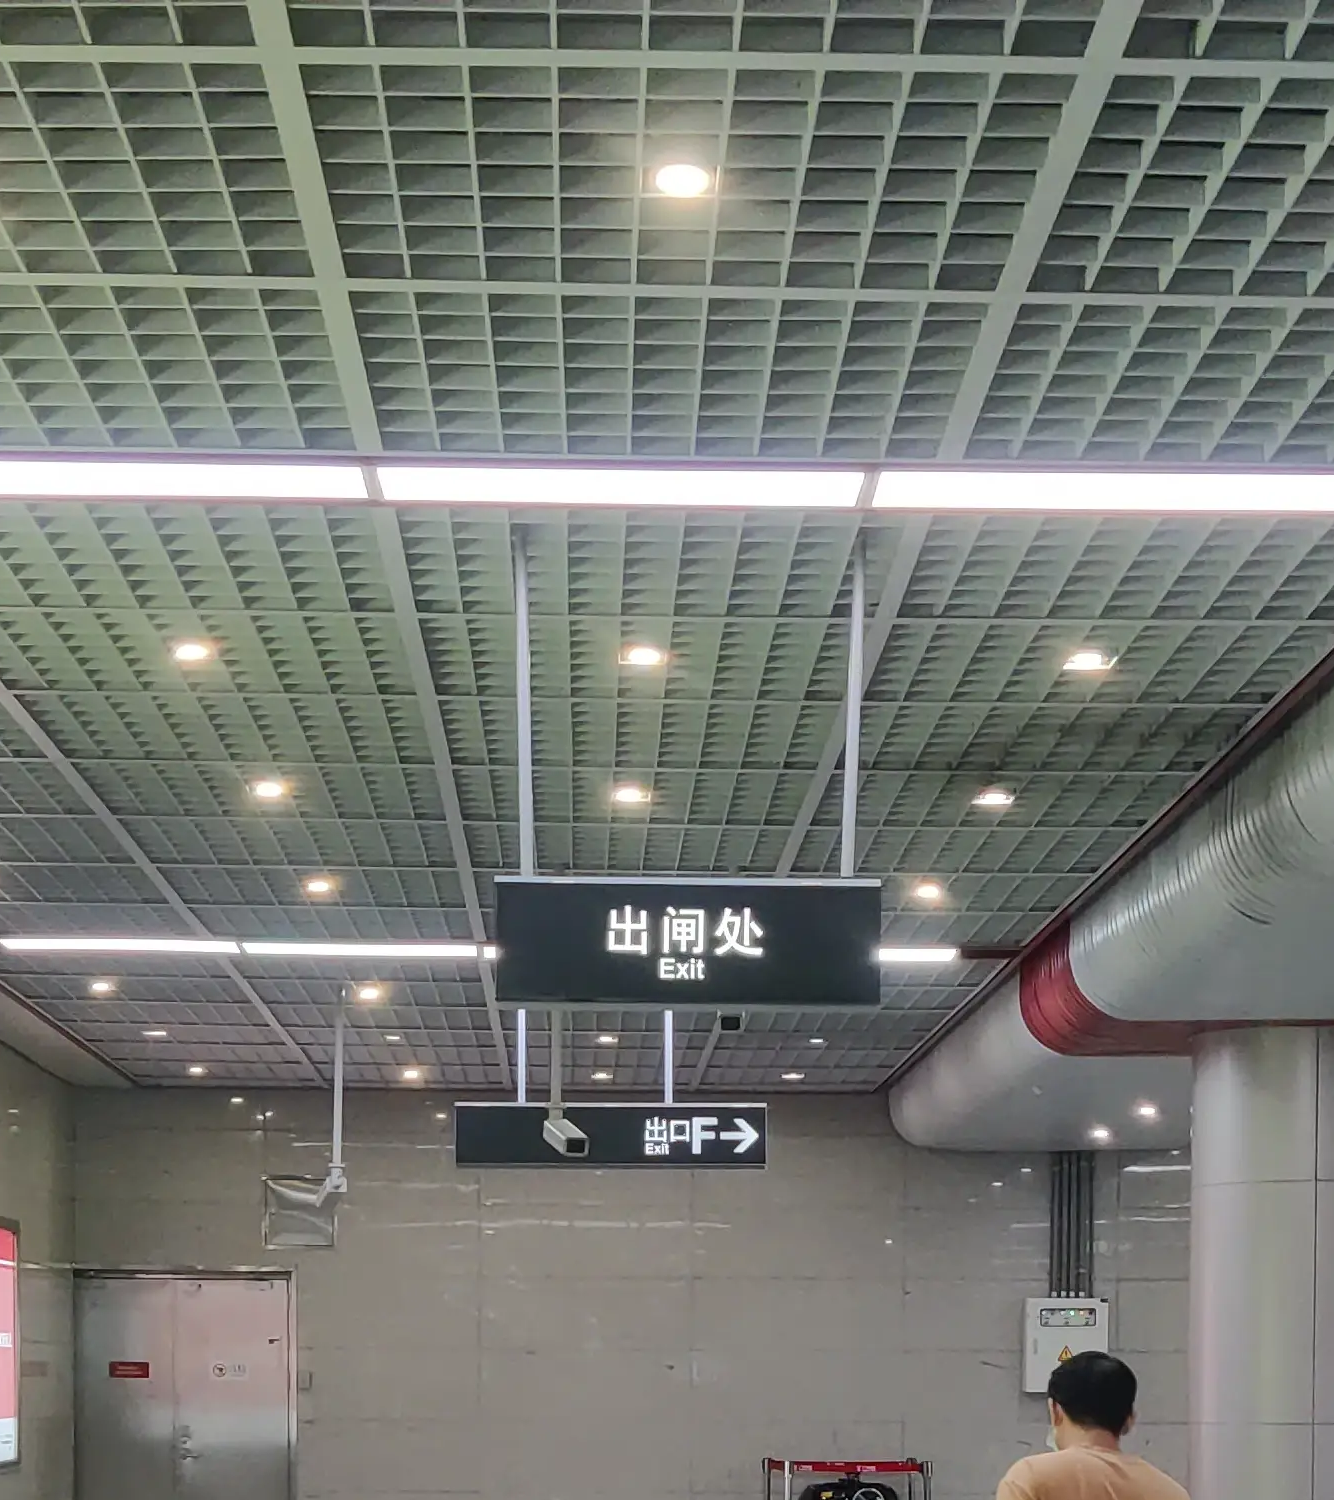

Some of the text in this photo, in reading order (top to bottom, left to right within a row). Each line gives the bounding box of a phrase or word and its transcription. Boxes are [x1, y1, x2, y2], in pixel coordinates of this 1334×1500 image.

[607, 904, 764, 956] 出闸处
[659, 957, 706, 980] Exit
[644, 1116, 719, 1155] 出口 F
[644, 1142, 670, 1155] Exit
